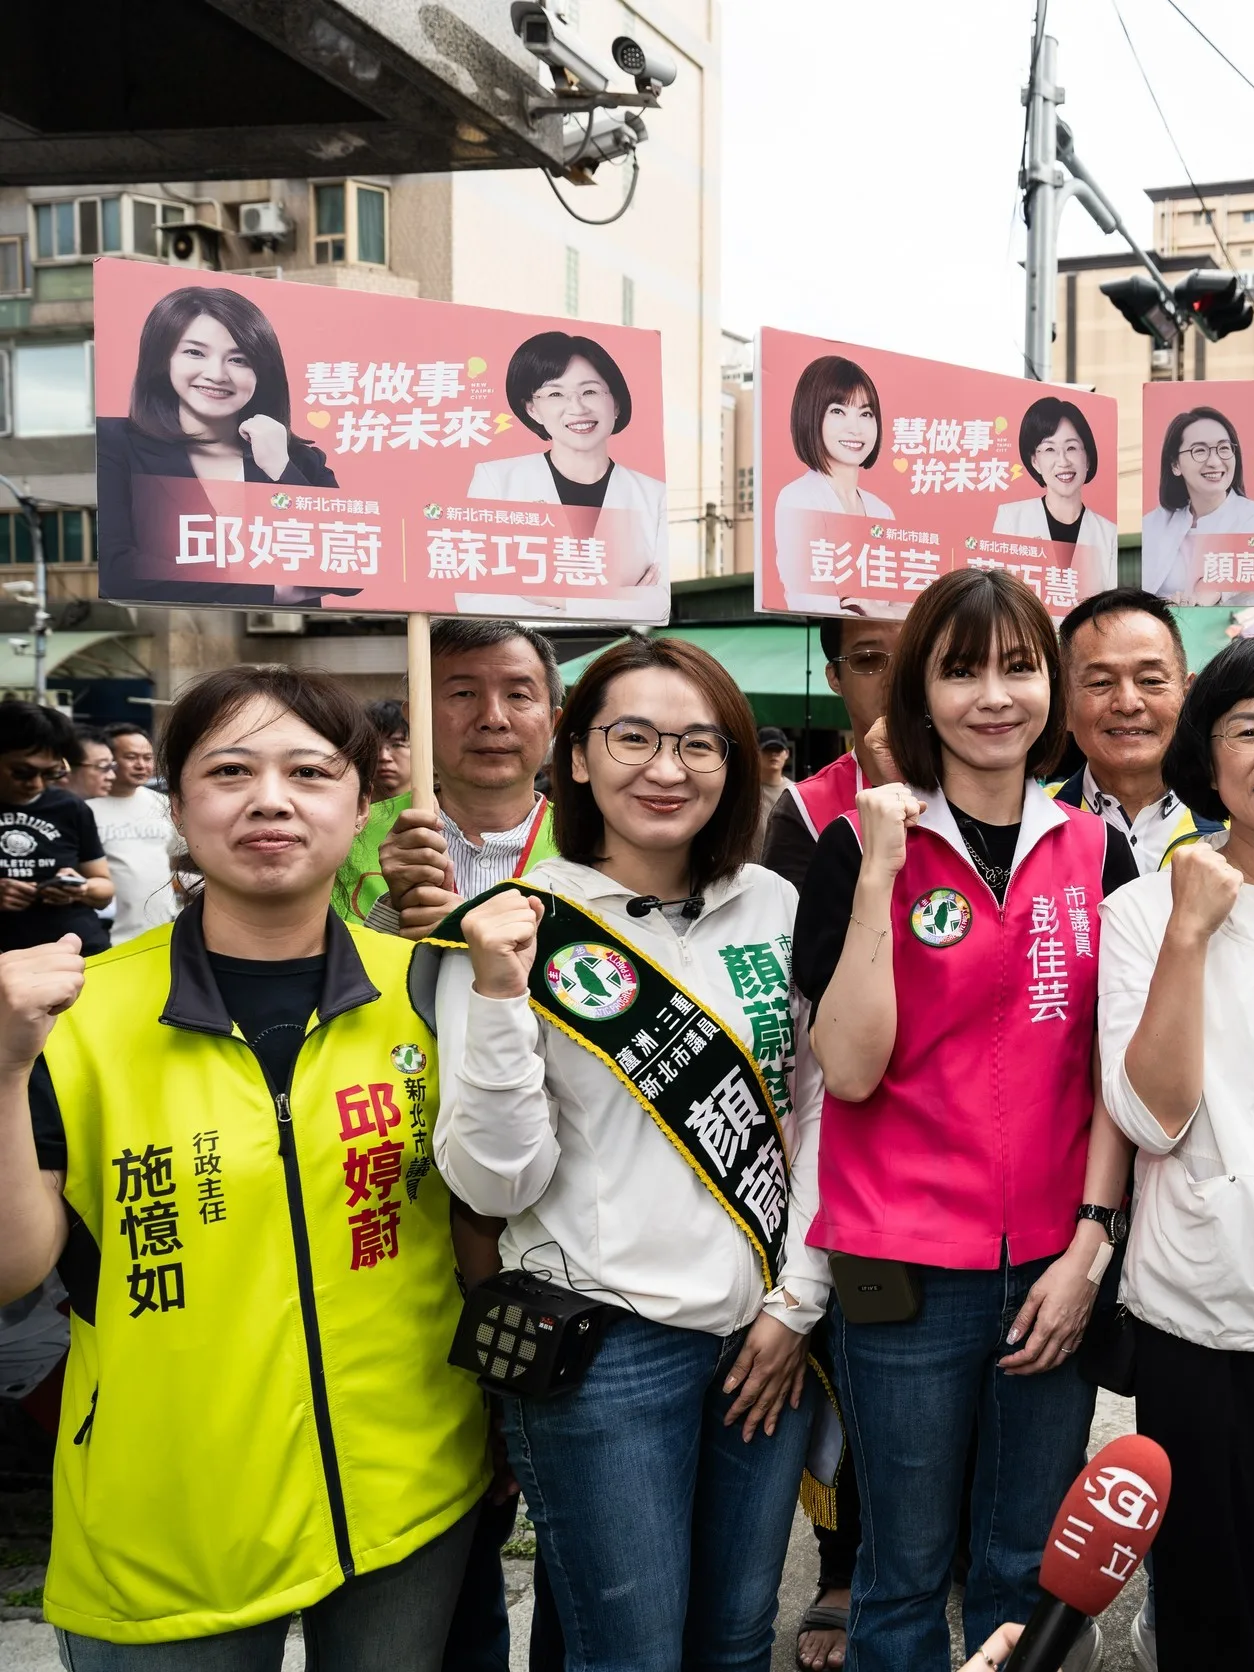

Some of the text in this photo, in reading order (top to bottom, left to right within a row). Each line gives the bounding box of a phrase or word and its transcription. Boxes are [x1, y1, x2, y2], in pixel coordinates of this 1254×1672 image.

[304, 361, 466, 407] 慧做事
[334, 406, 493, 455] 拚未來
[891, 417, 994, 458] 慧做事
[910, 457, 1010, 495] 拚未來
[295, 496, 380, 516] 新北市議員
[446, 507, 555, 528] 新北市長候選人
[175, 514, 382, 575] 邱婷蔚
[426, 528, 609, 586] 蘇巧慧
[886, 527, 940, 546] 新北市議員
[979, 539, 1047, 560] 新北市長候選人
[809, 538, 940, 591] 彭佳芸
[1064, 885, 1094, 958] 市議員
[1026, 894, 1069, 1023] 彭佳芸
[639, 1017, 721, 1100] 新北市議員
[193, 1130, 227, 1225] 行政主任
[335, 1082, 405, 1271] 邱婷蔚
[112, 1144, 185, 1319] 施憶如
